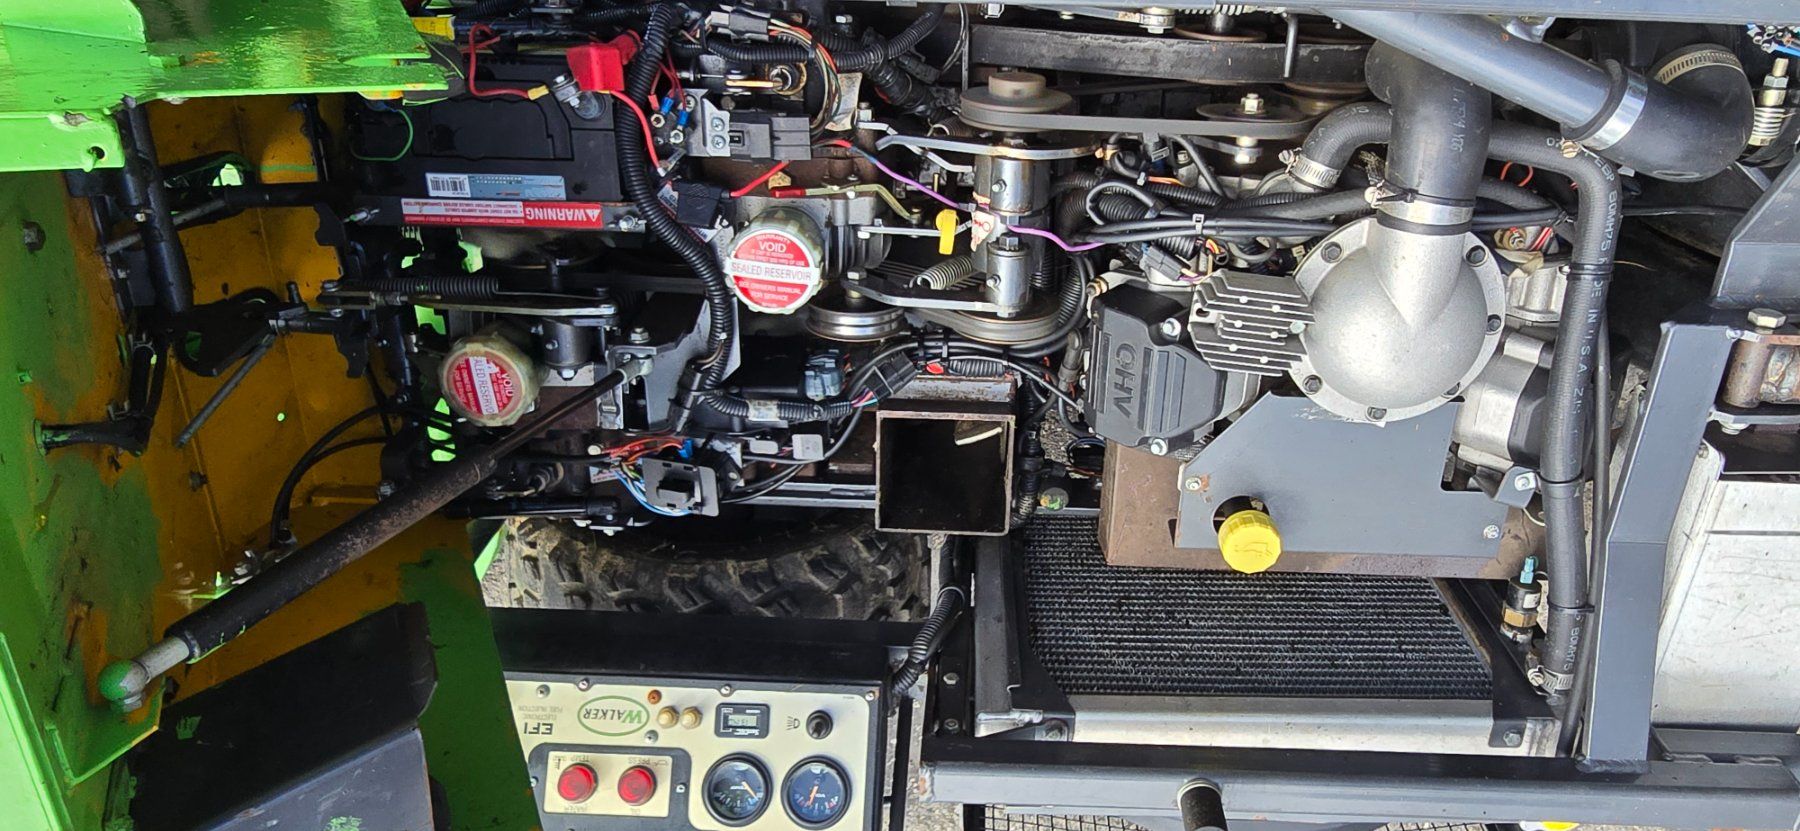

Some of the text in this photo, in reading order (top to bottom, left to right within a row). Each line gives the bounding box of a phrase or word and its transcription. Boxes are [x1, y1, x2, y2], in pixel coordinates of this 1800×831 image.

[526, 207, 587, 221] WARNING
[1601, 190, 1618, 251] 80MH75
[759, 241, 787, 253] VOID
[730, 262, 812, 281] SEALED RESERVOIR
[474, 358, 495, 414] ALED RESERVO
[1113, 343, 1137, 419] OHV
[523, 713, 557, 721] ELECTRONIC
[583, 708, 642, 725] WALKER
[524, 722, 554, 735] EFI
[571, 755, 590, 763] TEMP
[628, 758, 650, 766] PRESS
